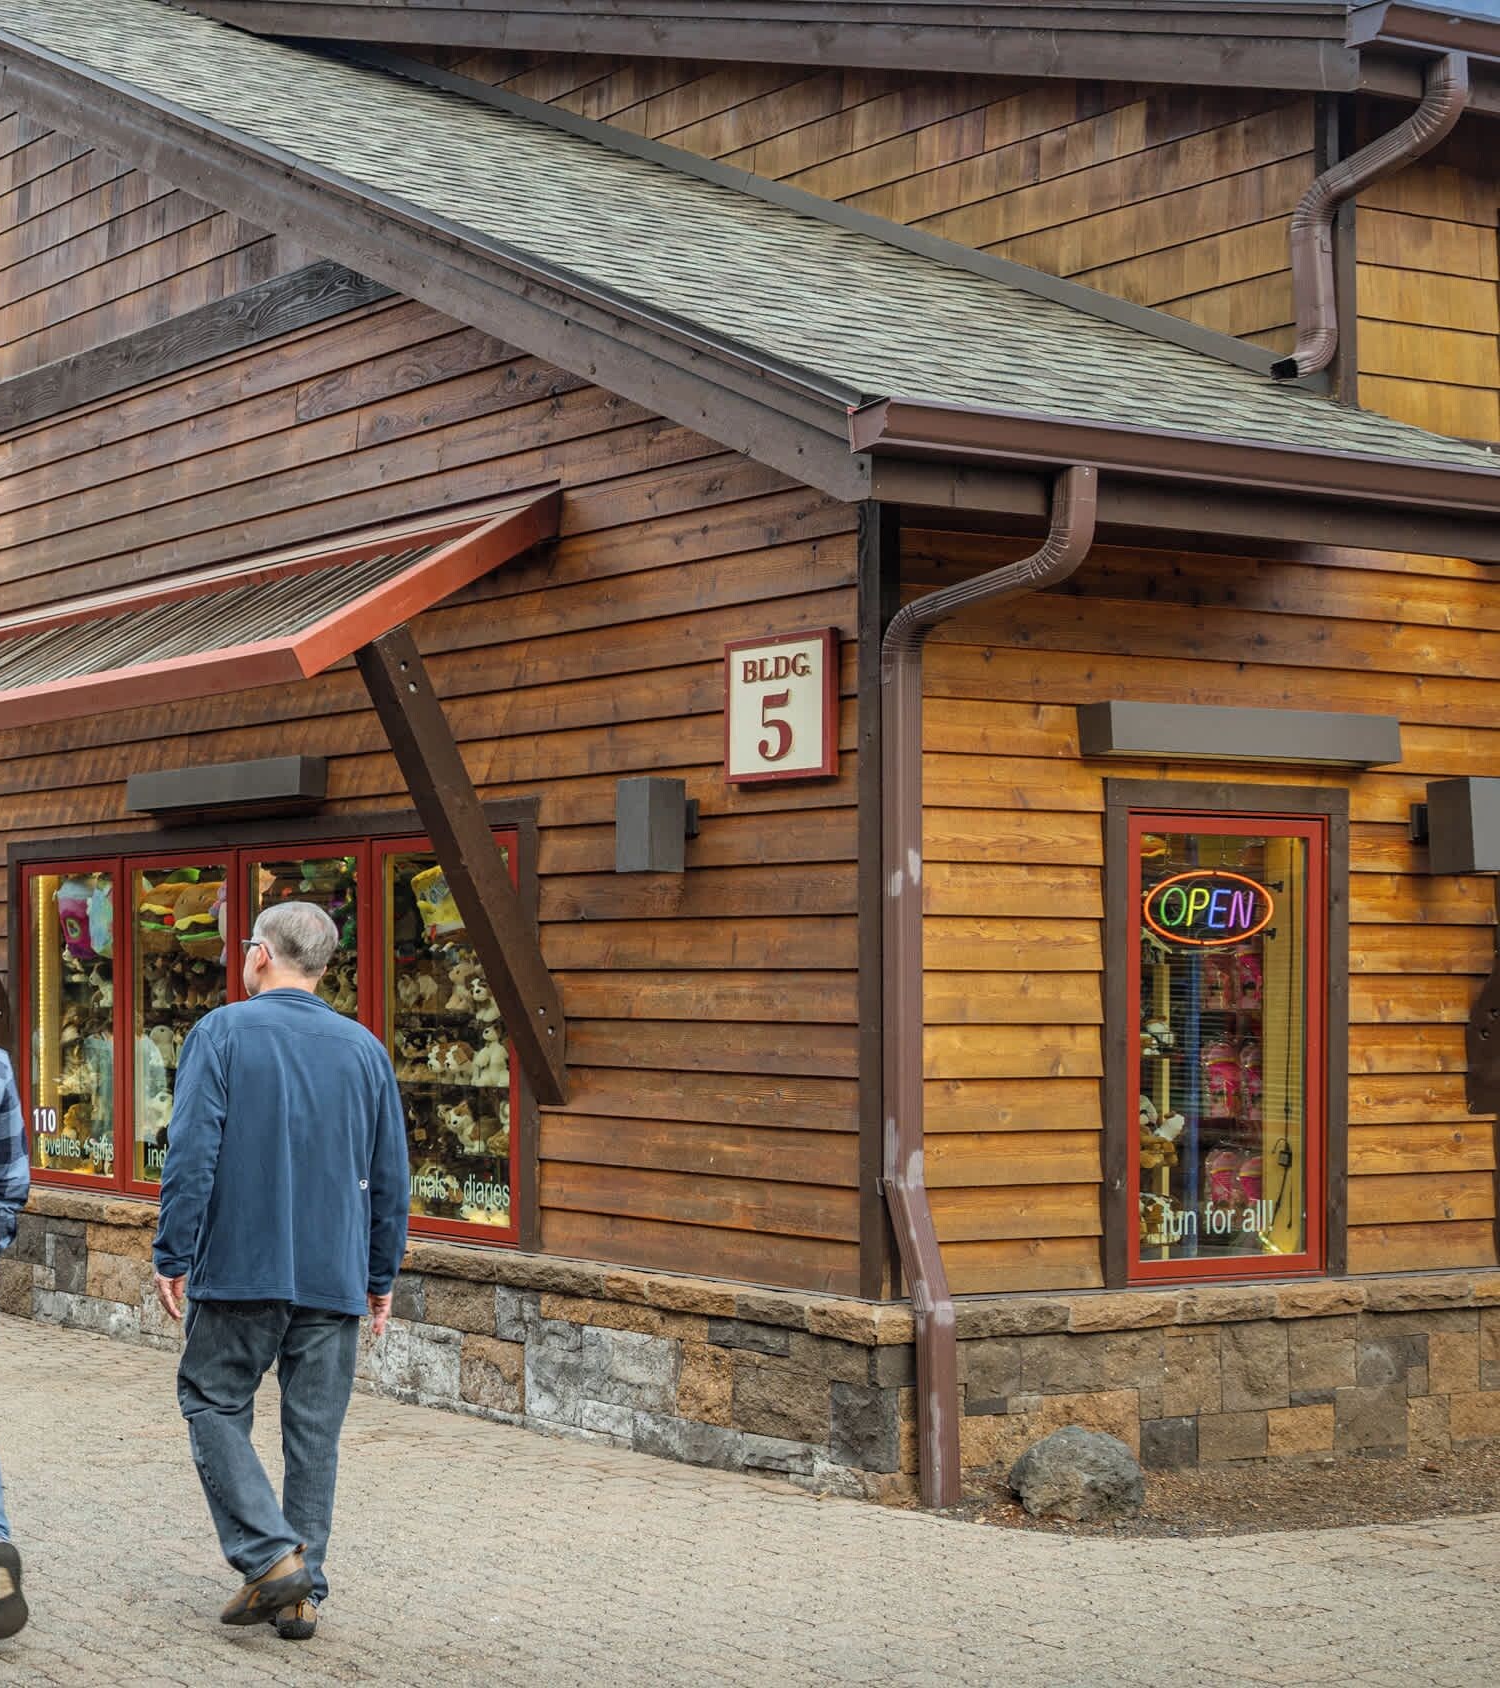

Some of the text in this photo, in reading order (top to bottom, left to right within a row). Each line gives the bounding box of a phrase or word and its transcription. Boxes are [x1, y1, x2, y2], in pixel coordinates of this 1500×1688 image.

[758, 689, 793, 762] 5
[1160, 887, 1254, 929] OPEN
[33, 1108, 56, 1132] 110
[37, 1134, 80, 1157] novelties
[93, 1134, 114, 1166] gifts
[463, 1174, 510, 1207] diaries
[1161, 1199, 1274, 1235] fun for all!
